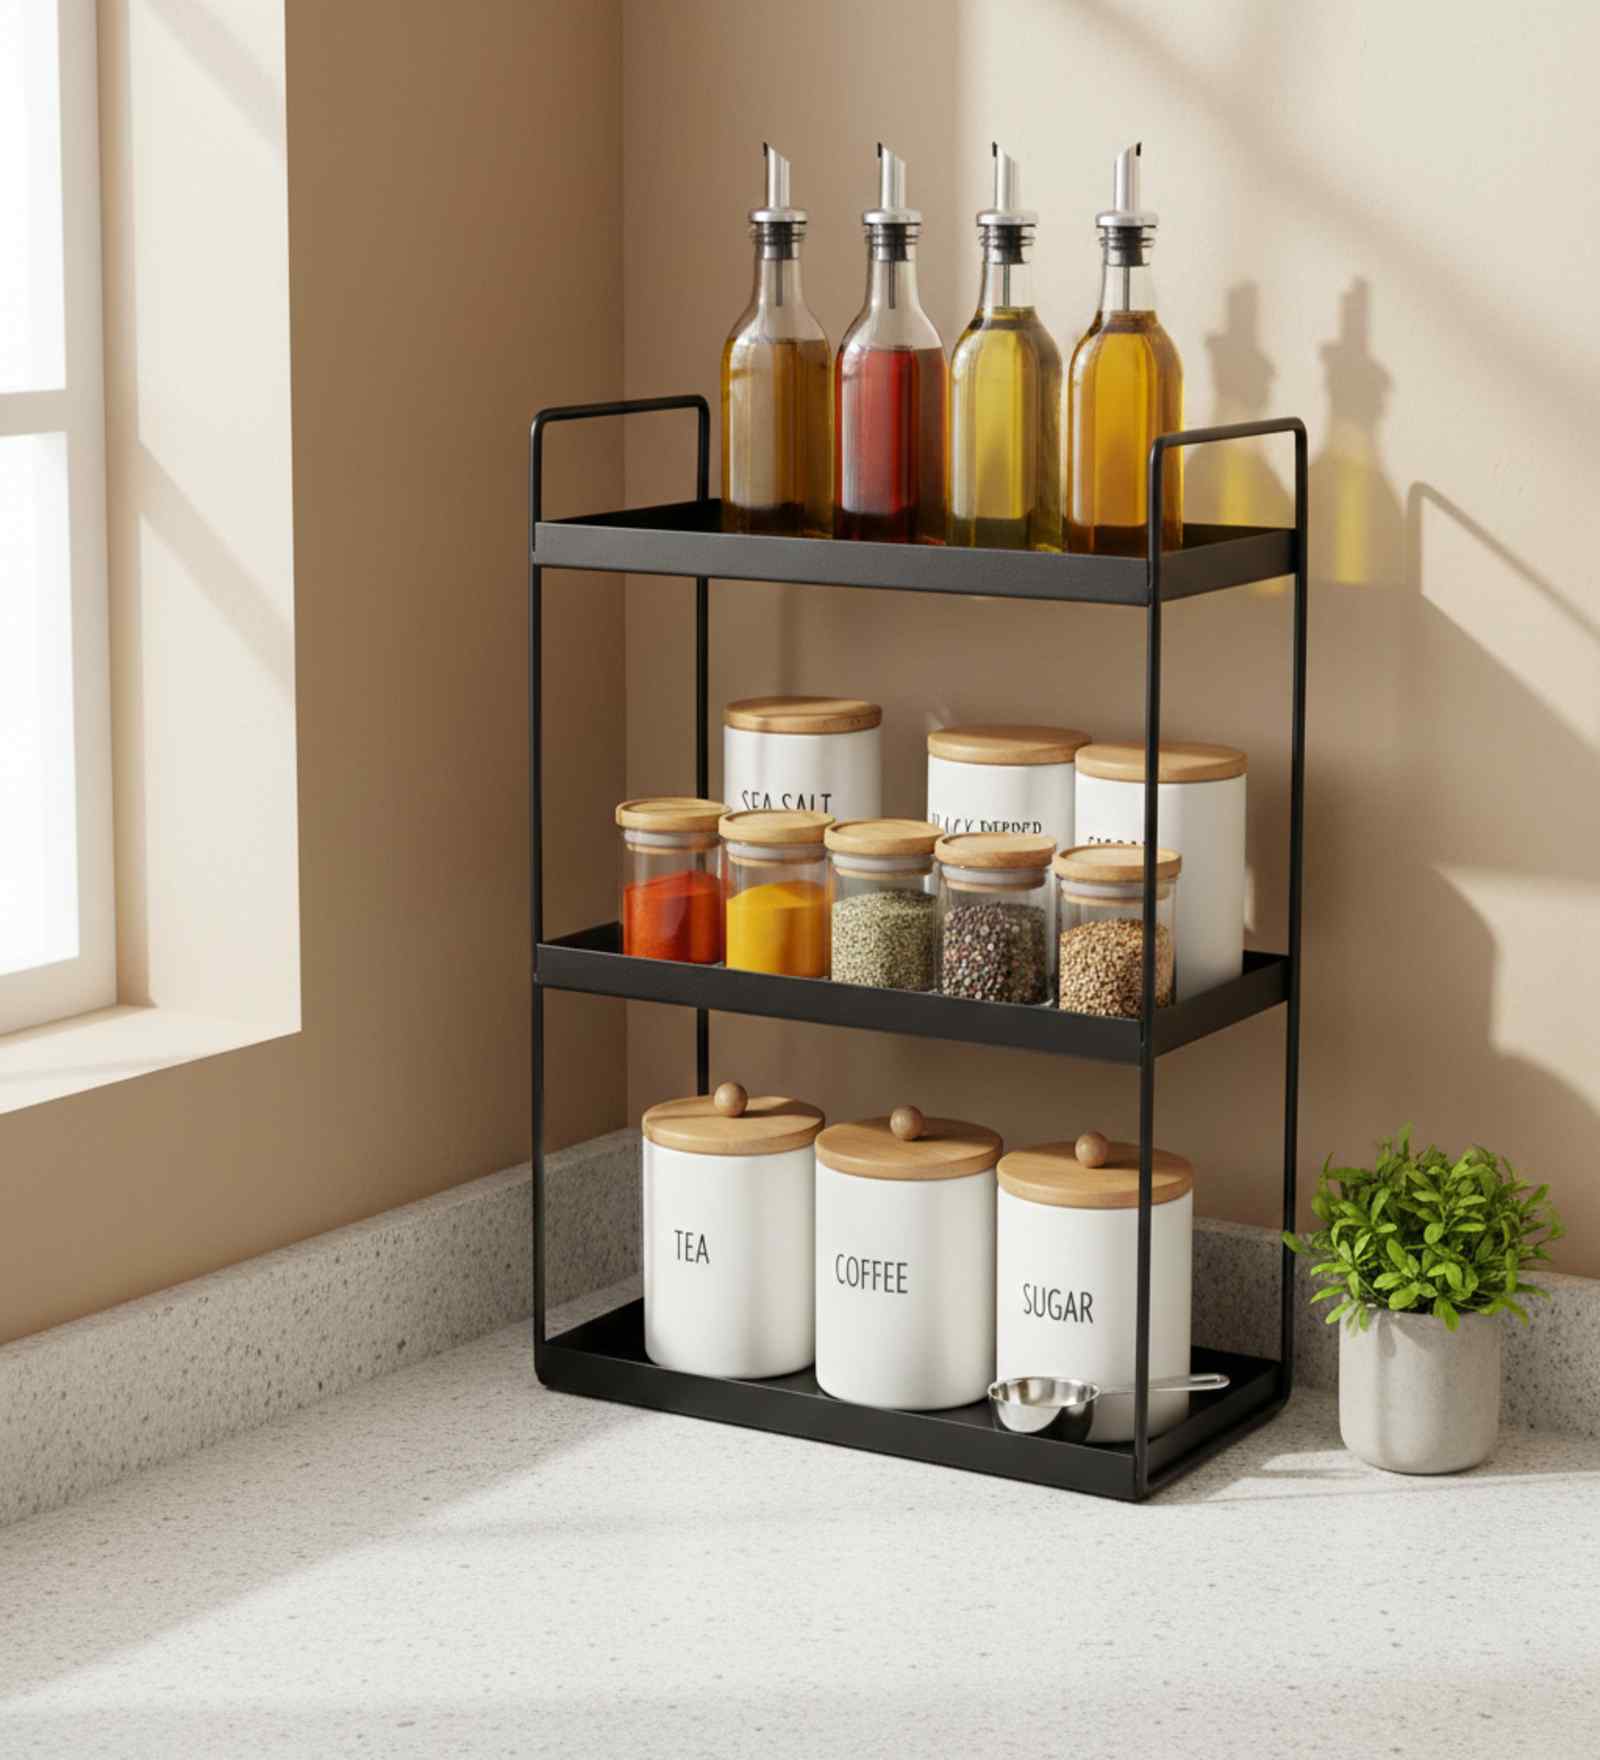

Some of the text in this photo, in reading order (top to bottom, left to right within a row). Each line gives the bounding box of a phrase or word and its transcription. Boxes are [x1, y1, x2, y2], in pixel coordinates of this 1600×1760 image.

[674, 1229, 710, 1264] TEA
[835, 1253, 908, 1294] COFFEE
[1023, 1282, 1094, 1324] SUGAR
